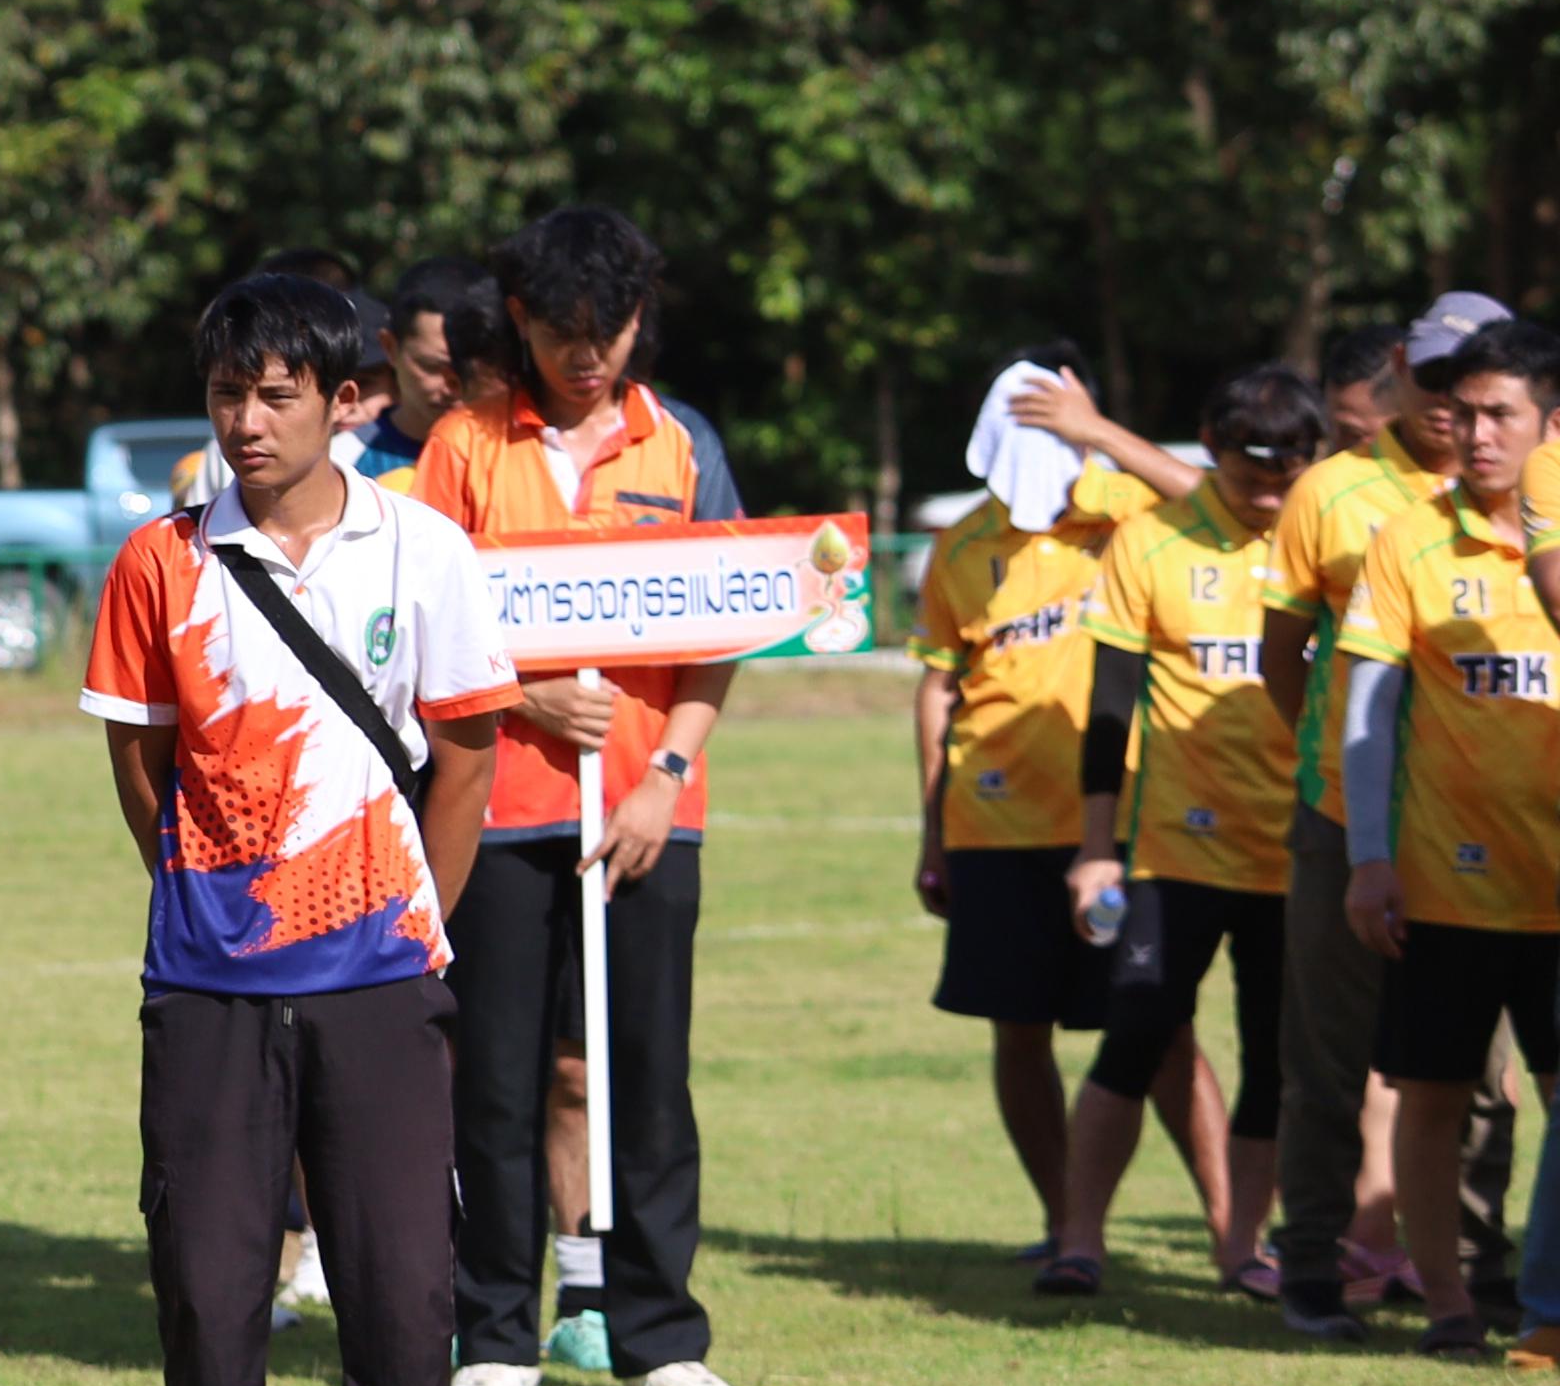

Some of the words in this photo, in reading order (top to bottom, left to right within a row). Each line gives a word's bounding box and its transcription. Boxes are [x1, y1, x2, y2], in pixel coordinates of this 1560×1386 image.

[1190, 566, 1220, 600] 12
[1451, 577, 1485, 616] 21
[1189, 635, 1262, 674] TA
[1452, 653, 1549, 696] TAK
